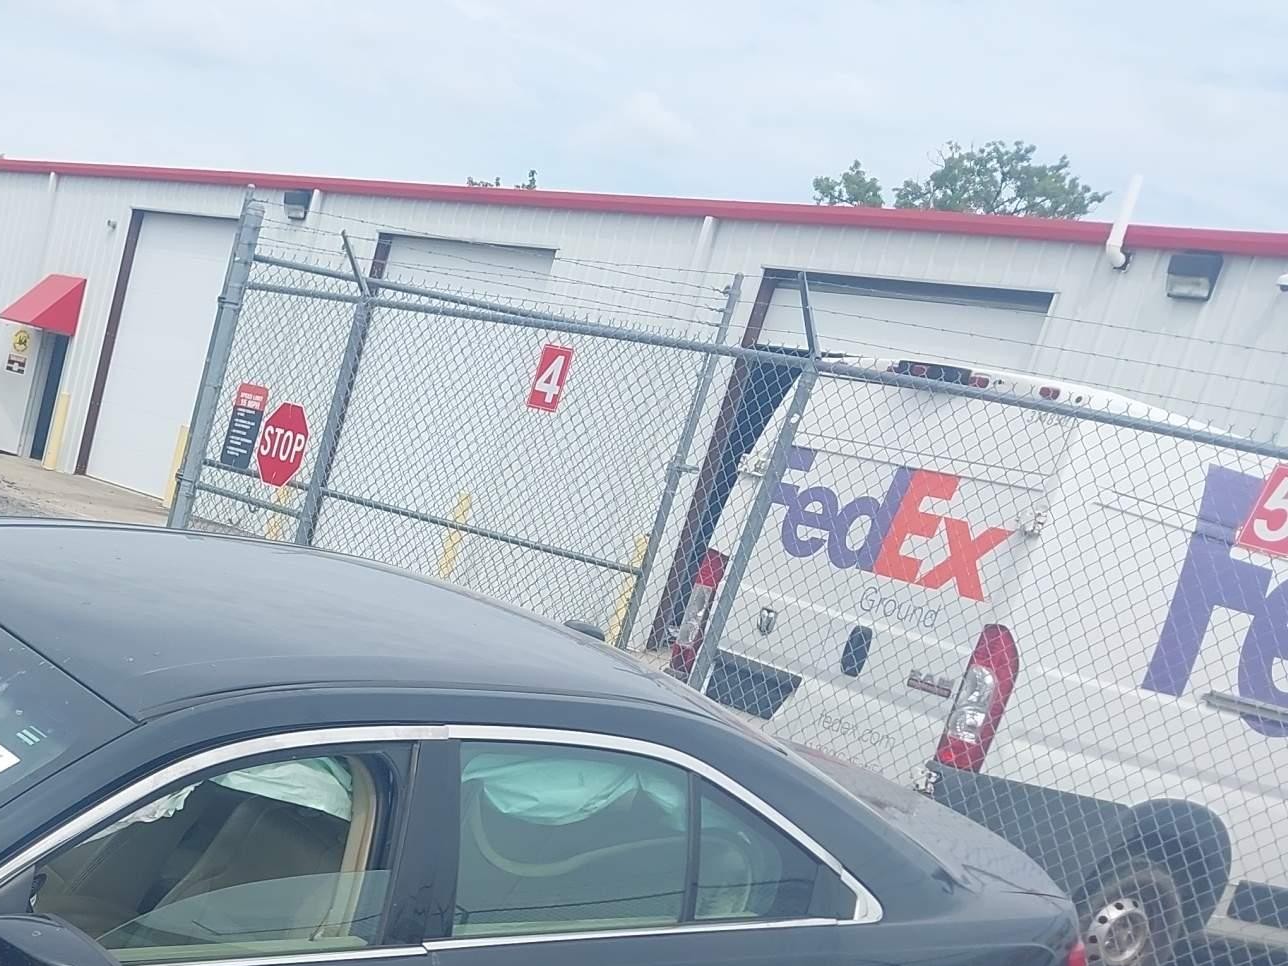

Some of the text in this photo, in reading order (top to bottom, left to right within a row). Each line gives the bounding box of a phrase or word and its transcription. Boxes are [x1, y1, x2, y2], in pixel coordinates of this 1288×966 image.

[535, 355, 566, 404] 4
[260, 425, 306, 464] STOP
[1253, 476, 1288, 542] 5
[861, 586, 941, 629] Ground
